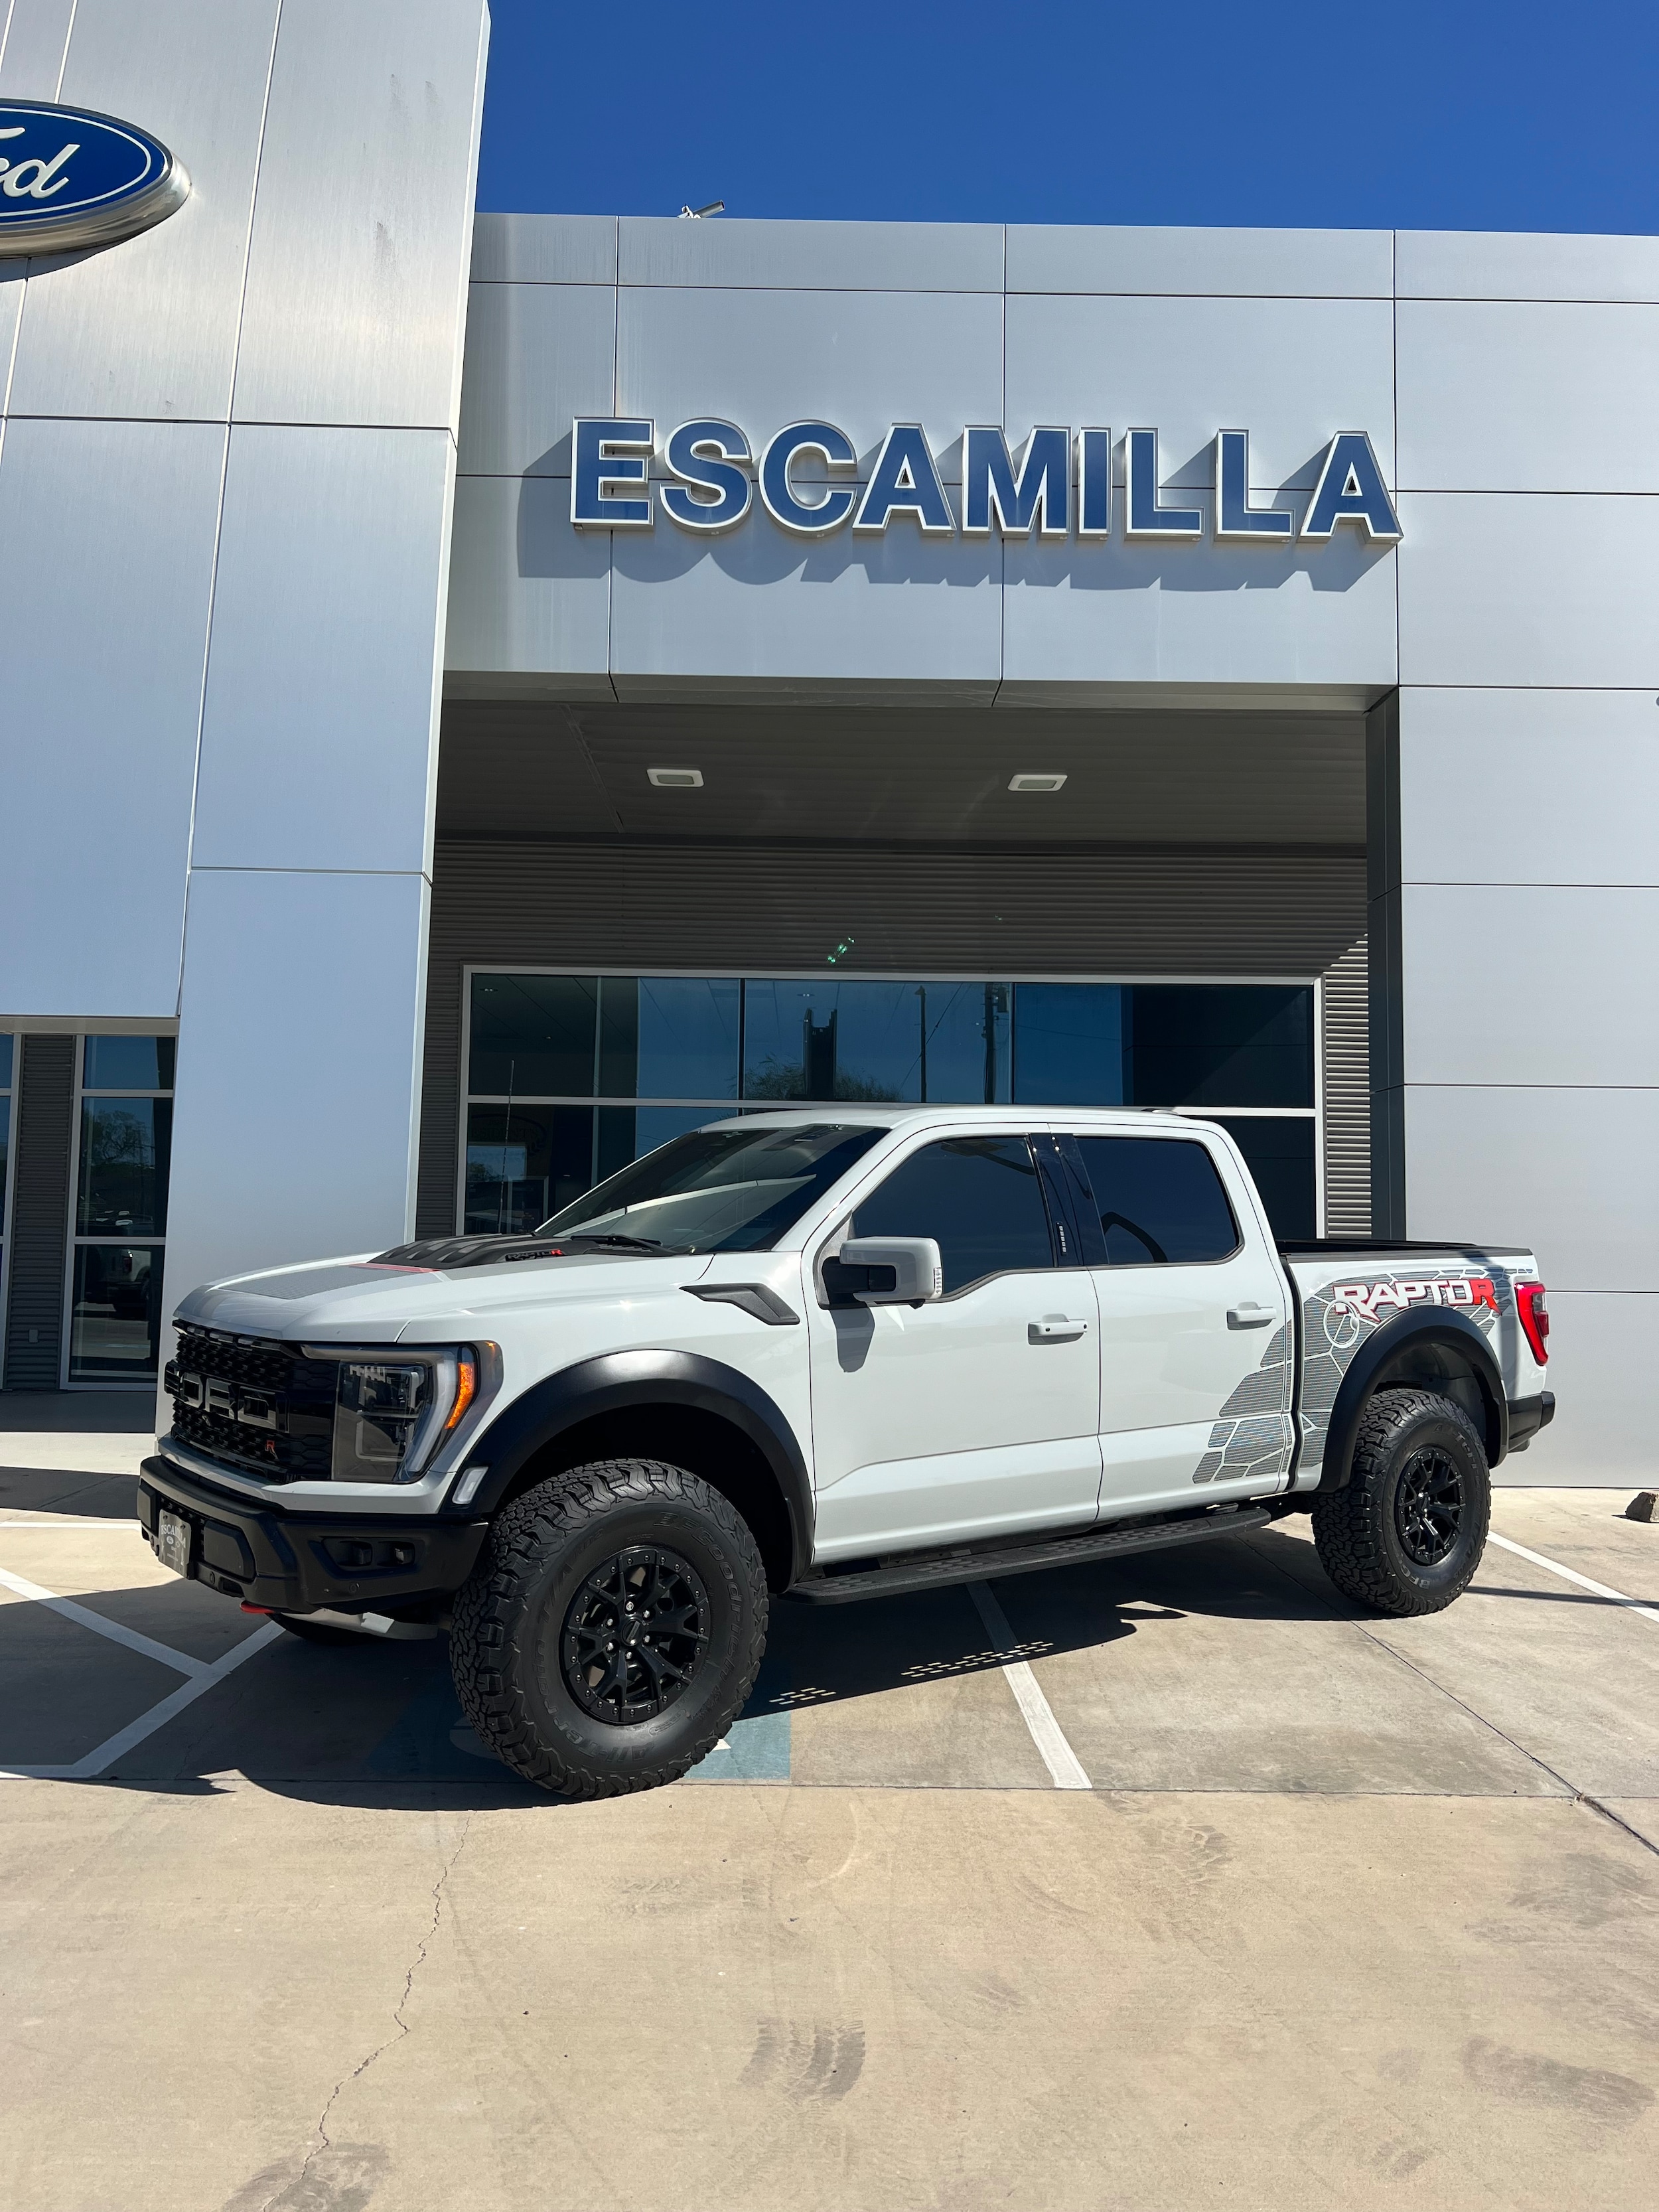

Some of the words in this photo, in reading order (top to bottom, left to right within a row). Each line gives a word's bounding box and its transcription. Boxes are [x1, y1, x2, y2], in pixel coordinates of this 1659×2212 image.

[570, 416, 1404, 543] ESCAMILLA
[1333, 1278, 1502, 1322] RAPTOR
[654, 1511, 743, 1683] BFGoodrich
[533, 1639, 655, 1762] All-Terrain
